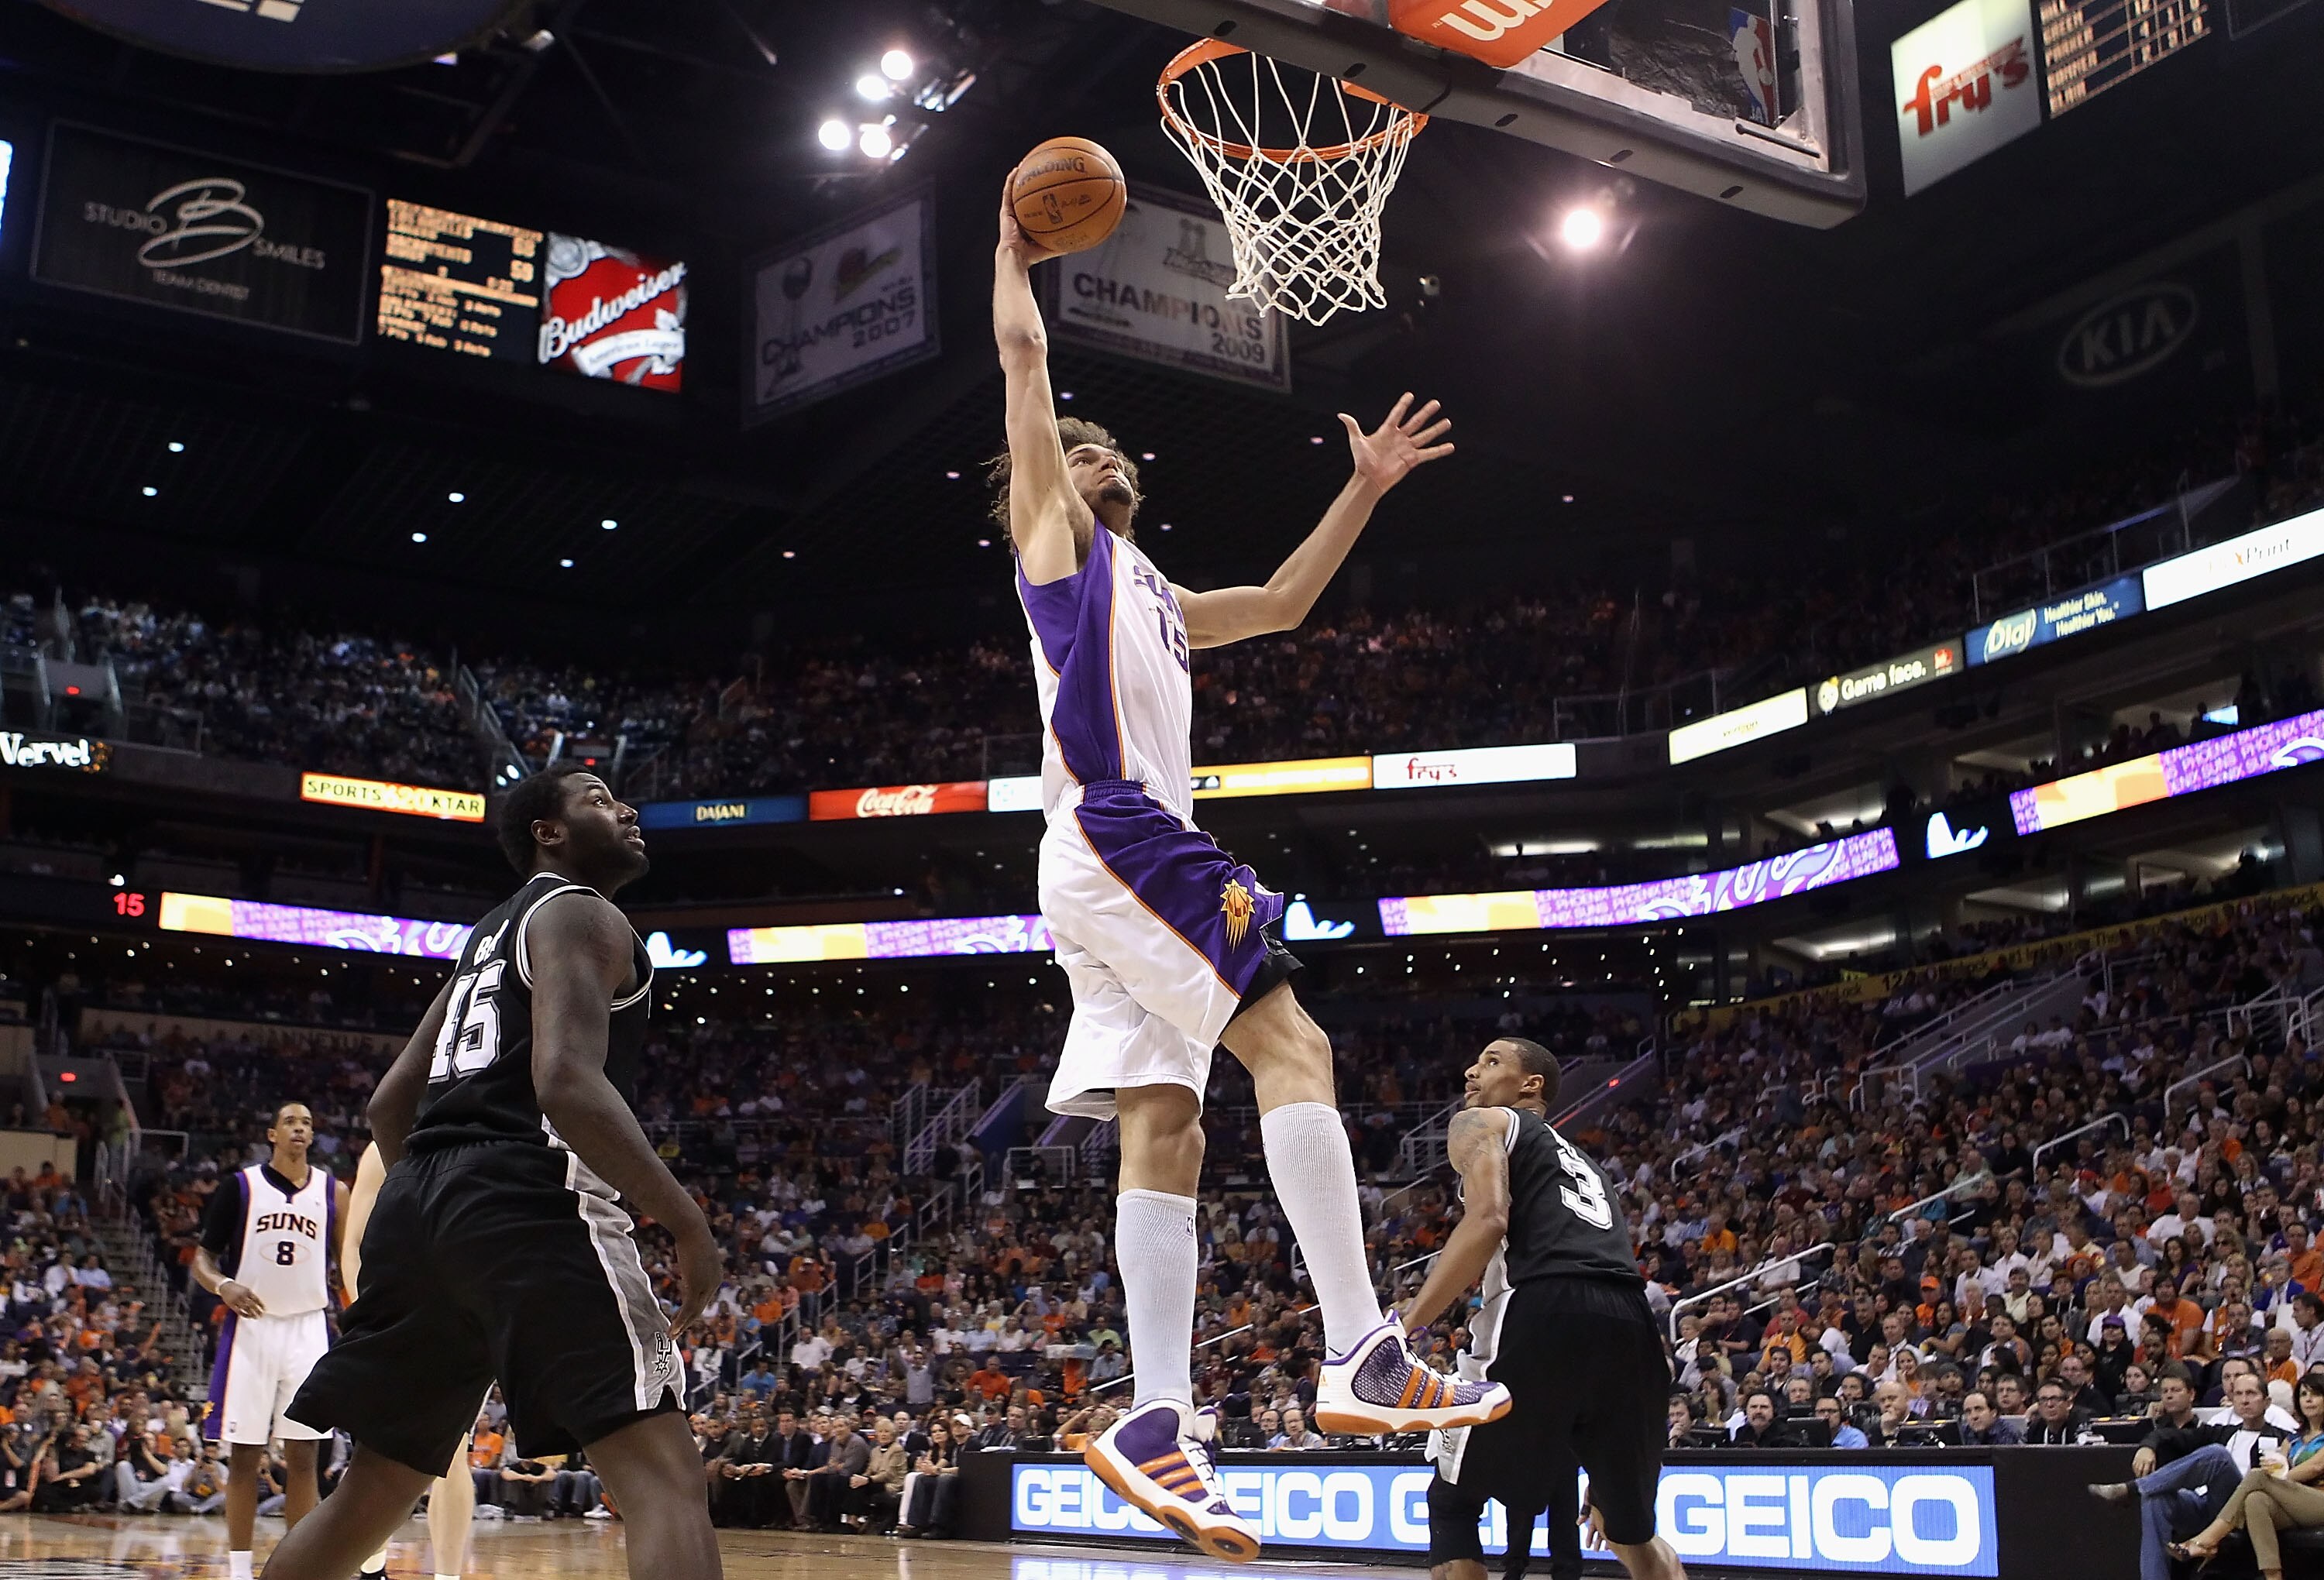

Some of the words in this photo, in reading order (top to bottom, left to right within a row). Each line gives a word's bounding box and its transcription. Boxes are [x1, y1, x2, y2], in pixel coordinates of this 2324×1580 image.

[84, 201, 167, 235] STUDIO
[252, 235, 326, 271] SMILES
[538, 260, 688, 365] Budweiser
[762, 285, 916, 367] CHAMPIONS
[1073, 273, 1263, 343] CHAMPIONS
[2083, 299, 2175, 372] KIA
[1210, 331, 1266, 364] 2009
[1157, 606, 1189, 675] 15
[1988, 617, 2033, 654] Dial
[0, 731, 91, 768] Verve!
[308, 781, 382, 802] SPORTS
[432, 795, 480, 813] KTAR
[696, 804, 746, 823] DASANI
[114, 891, 146, 918] 15
[428, 959, 507, 1084] 45
[1556, 1146, 1614, 1231] 3
[256, 1212, 318, 1241] SUNS
[276, 1241, 295, 1266] 8
[1213, 1471, 1374, 1542] EICO
[1655, 1473, 1982, 1567] GEICO
